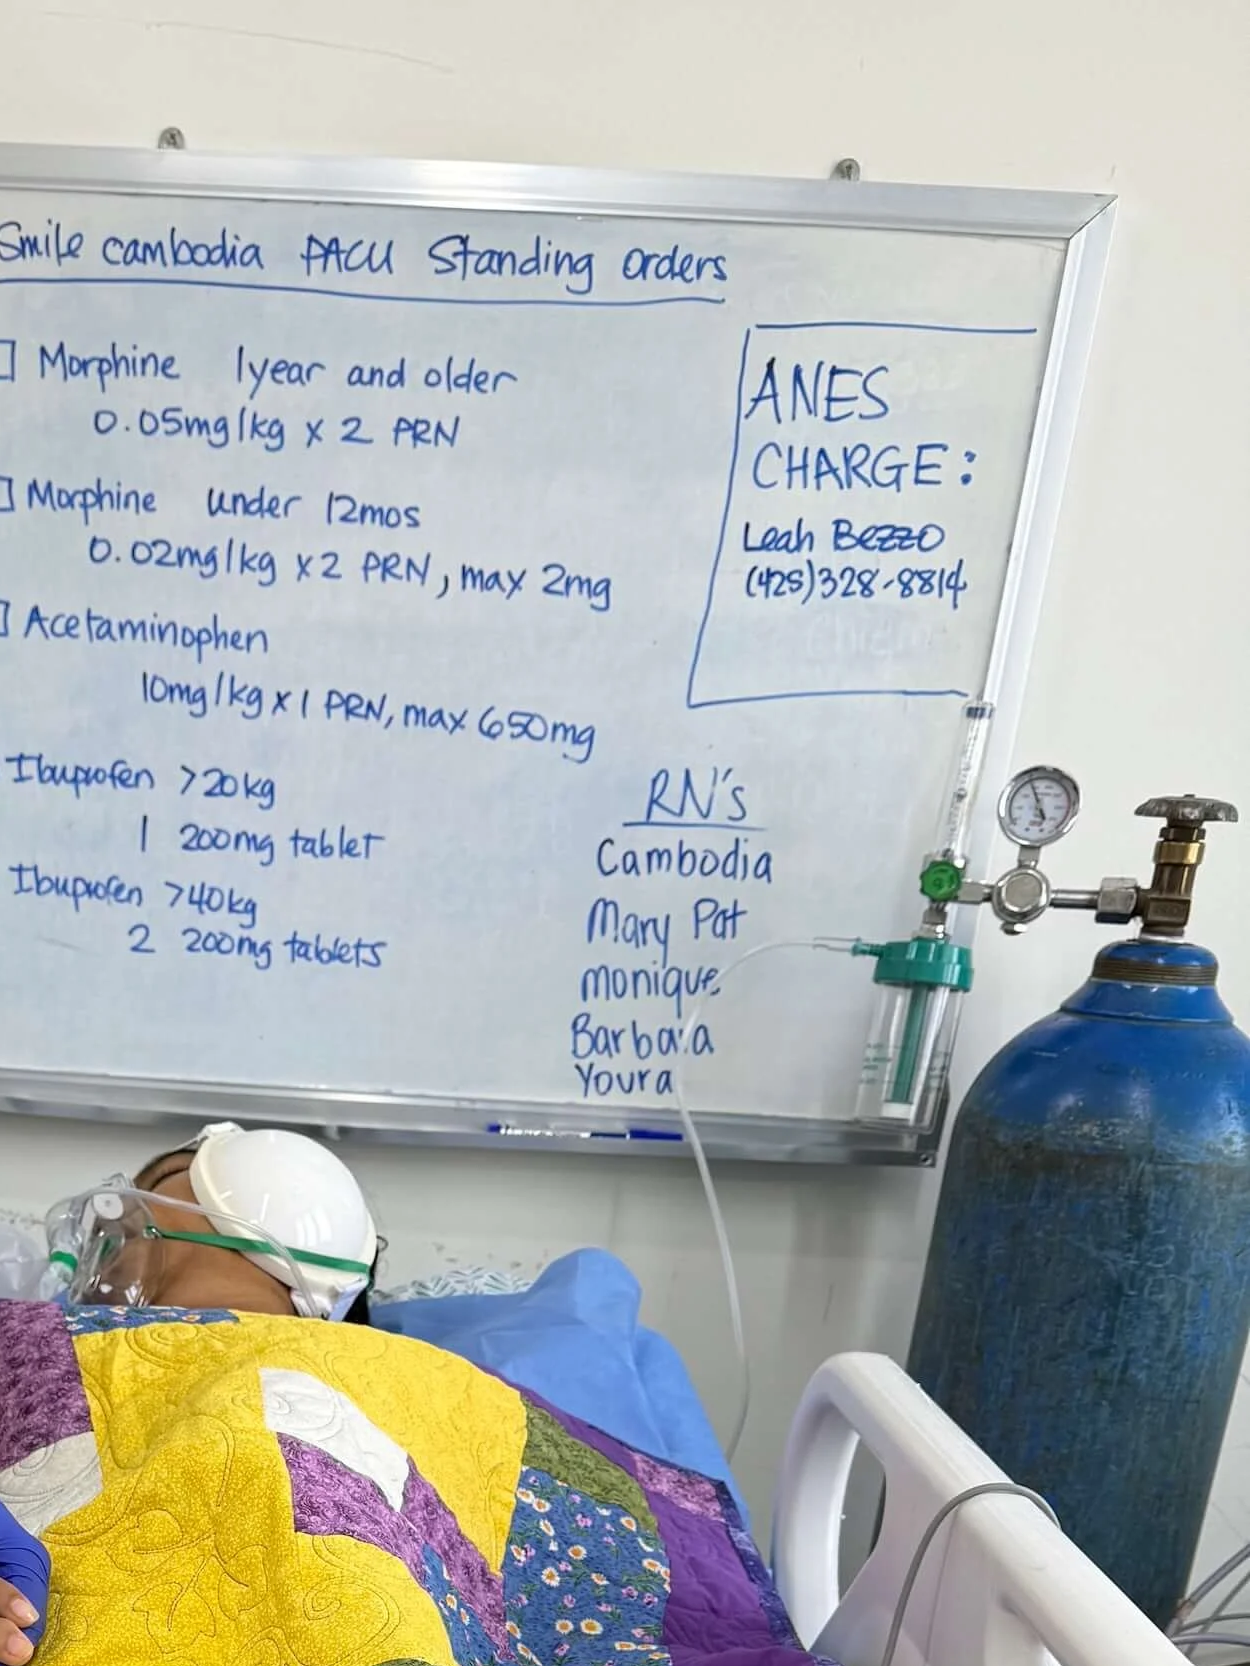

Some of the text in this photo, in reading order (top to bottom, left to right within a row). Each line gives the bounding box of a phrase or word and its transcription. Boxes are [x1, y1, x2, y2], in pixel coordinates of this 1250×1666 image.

[300, 234, 393, 274] PACU
[428, 234, 594, 295] Standing
[39, 341, 180, 392] Morphine
[347, 358, 405, 389] and
[424, 356, 517, 394] older
[743, 358, 889, 424] ANES
[340, 416, 374, 444] 2
[392, 416, 460, 447] PRN
[752, 442, 975, 493] CHARGE:
[27, 477, 156, 526] Morphine
[207, 485, 302, 519] under
[743, 519, 814, 554] Leah
[461, 566, 526, 600] max
[542, 563, 611, 612] 2mg
[23, 606, 268, 664] Acetaminophen
[403, 704, 468, 735] max
[478, 706, 595, 764] 650mg
[4, 752, 155, 800] Ibuprofen
[646, 767, 747, 822] RN's
[179, 822, 274, 867] 200mg
[289, 824, 385, 860] tablet
[597, 837, 772, 884] Cambodia
[8, 862, 143, 912] Ibuprofen
[128, 922, 387, 970] 2 200mg tablets
[587, 898, 747, 970] Mary Pat
[574, 1061, 673, 1099] Youra
